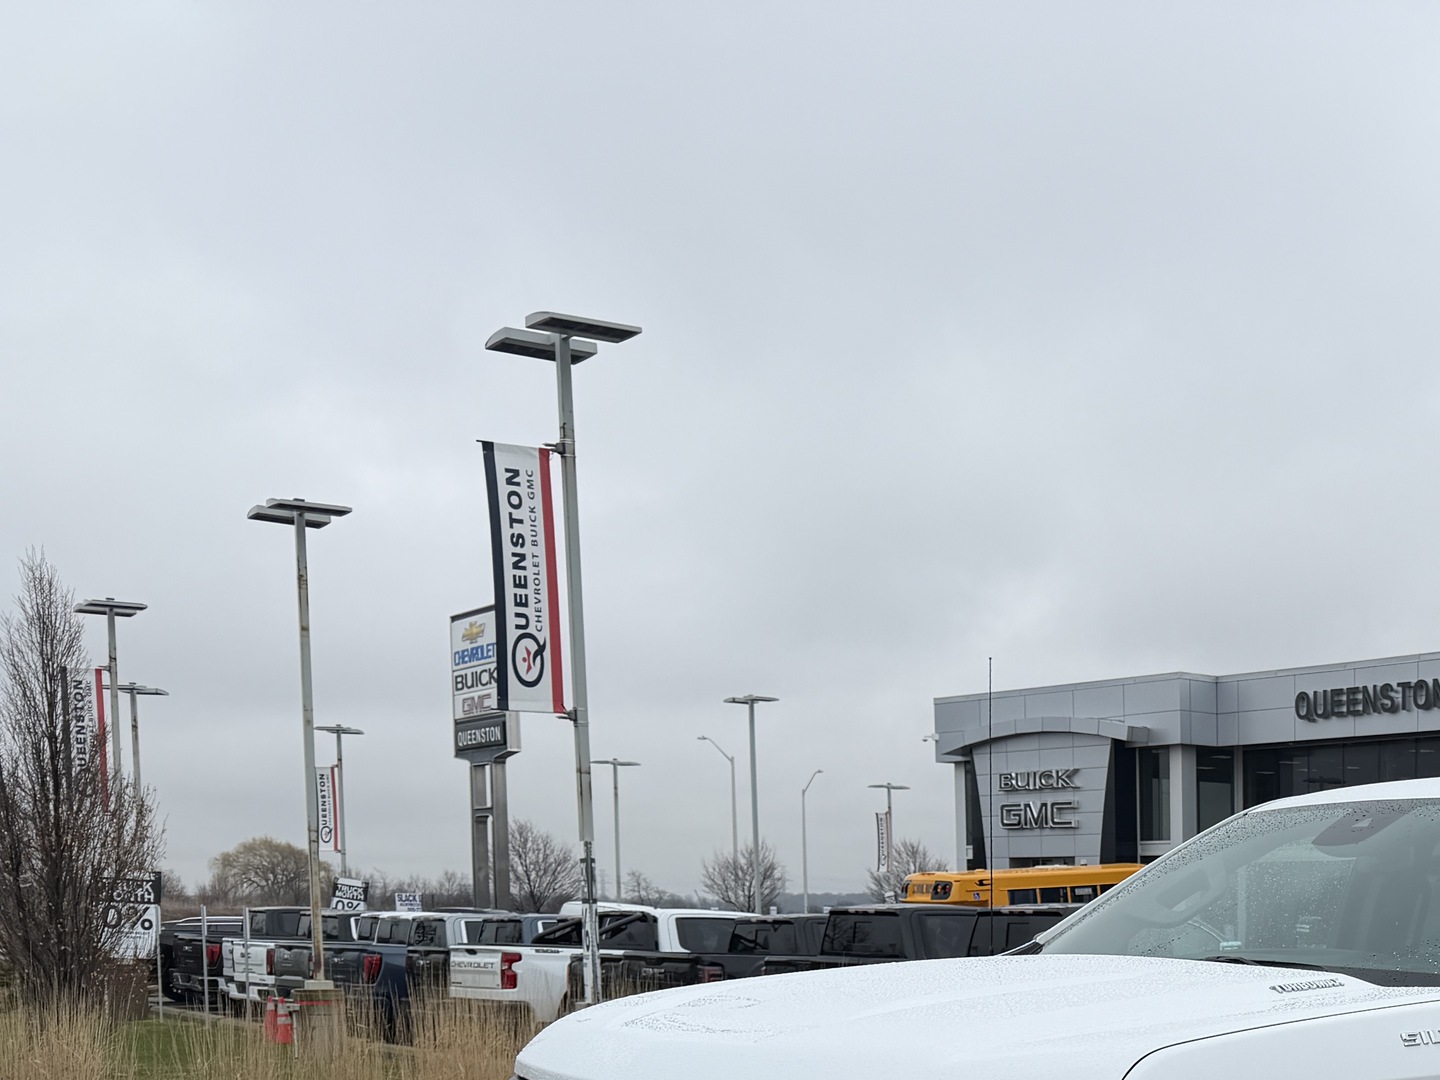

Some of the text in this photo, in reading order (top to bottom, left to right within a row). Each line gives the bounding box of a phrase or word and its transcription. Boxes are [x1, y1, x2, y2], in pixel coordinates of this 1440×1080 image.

[525, 469, 543, 633] CHEVROLET BUICK GMC
[504, 467, 546, 688] QUEENSTON
[454, 642, 496, 667] CHEVROLET
[455, 667, 498, 692] BUICK
[462, 693, 492, 716] GMC
[457, 726, 501, 747] QUEENSTON
[998, 768, 1081, 792] BUICK
[319, 774, 333, 844] QUEENSTON
[1000, 800, 1079, 829] GMC
[335, 890, 364, 900] MONTH
[337, 884, 364, 895] TRUCK
[451, 961, 494, 969] CHEVROLET
